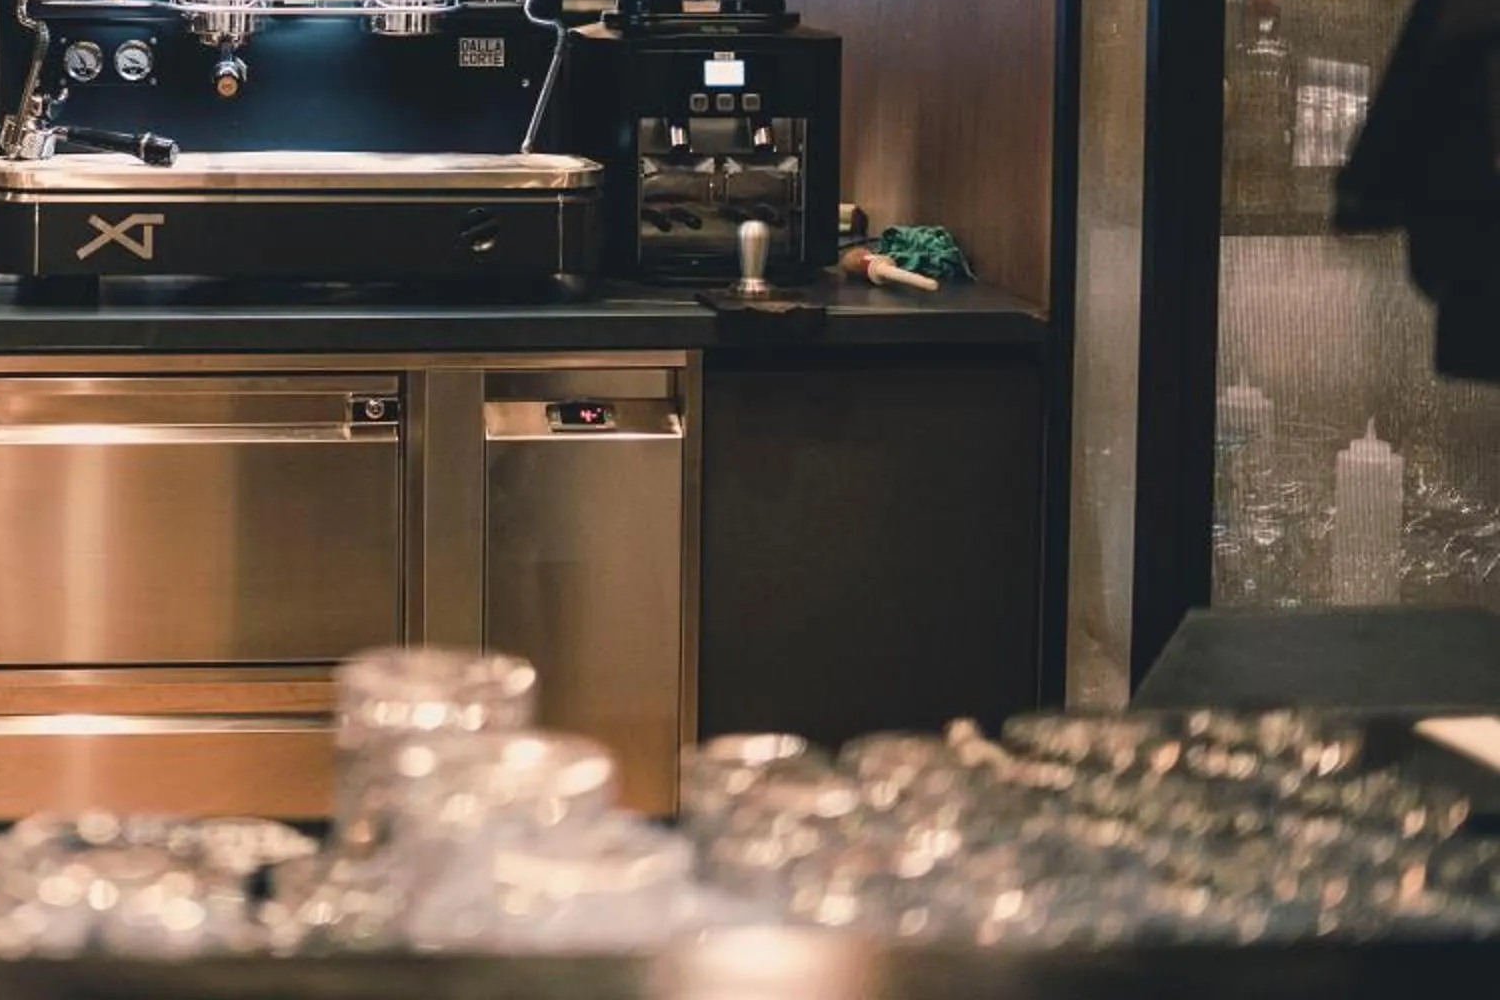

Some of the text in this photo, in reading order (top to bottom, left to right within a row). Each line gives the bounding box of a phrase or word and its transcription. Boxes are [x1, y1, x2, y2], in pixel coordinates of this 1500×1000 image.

[461, 39, 503, 52] DALLA
[461, 53, 503, 65] CORTE
[76, 213, 164, 260] XT
